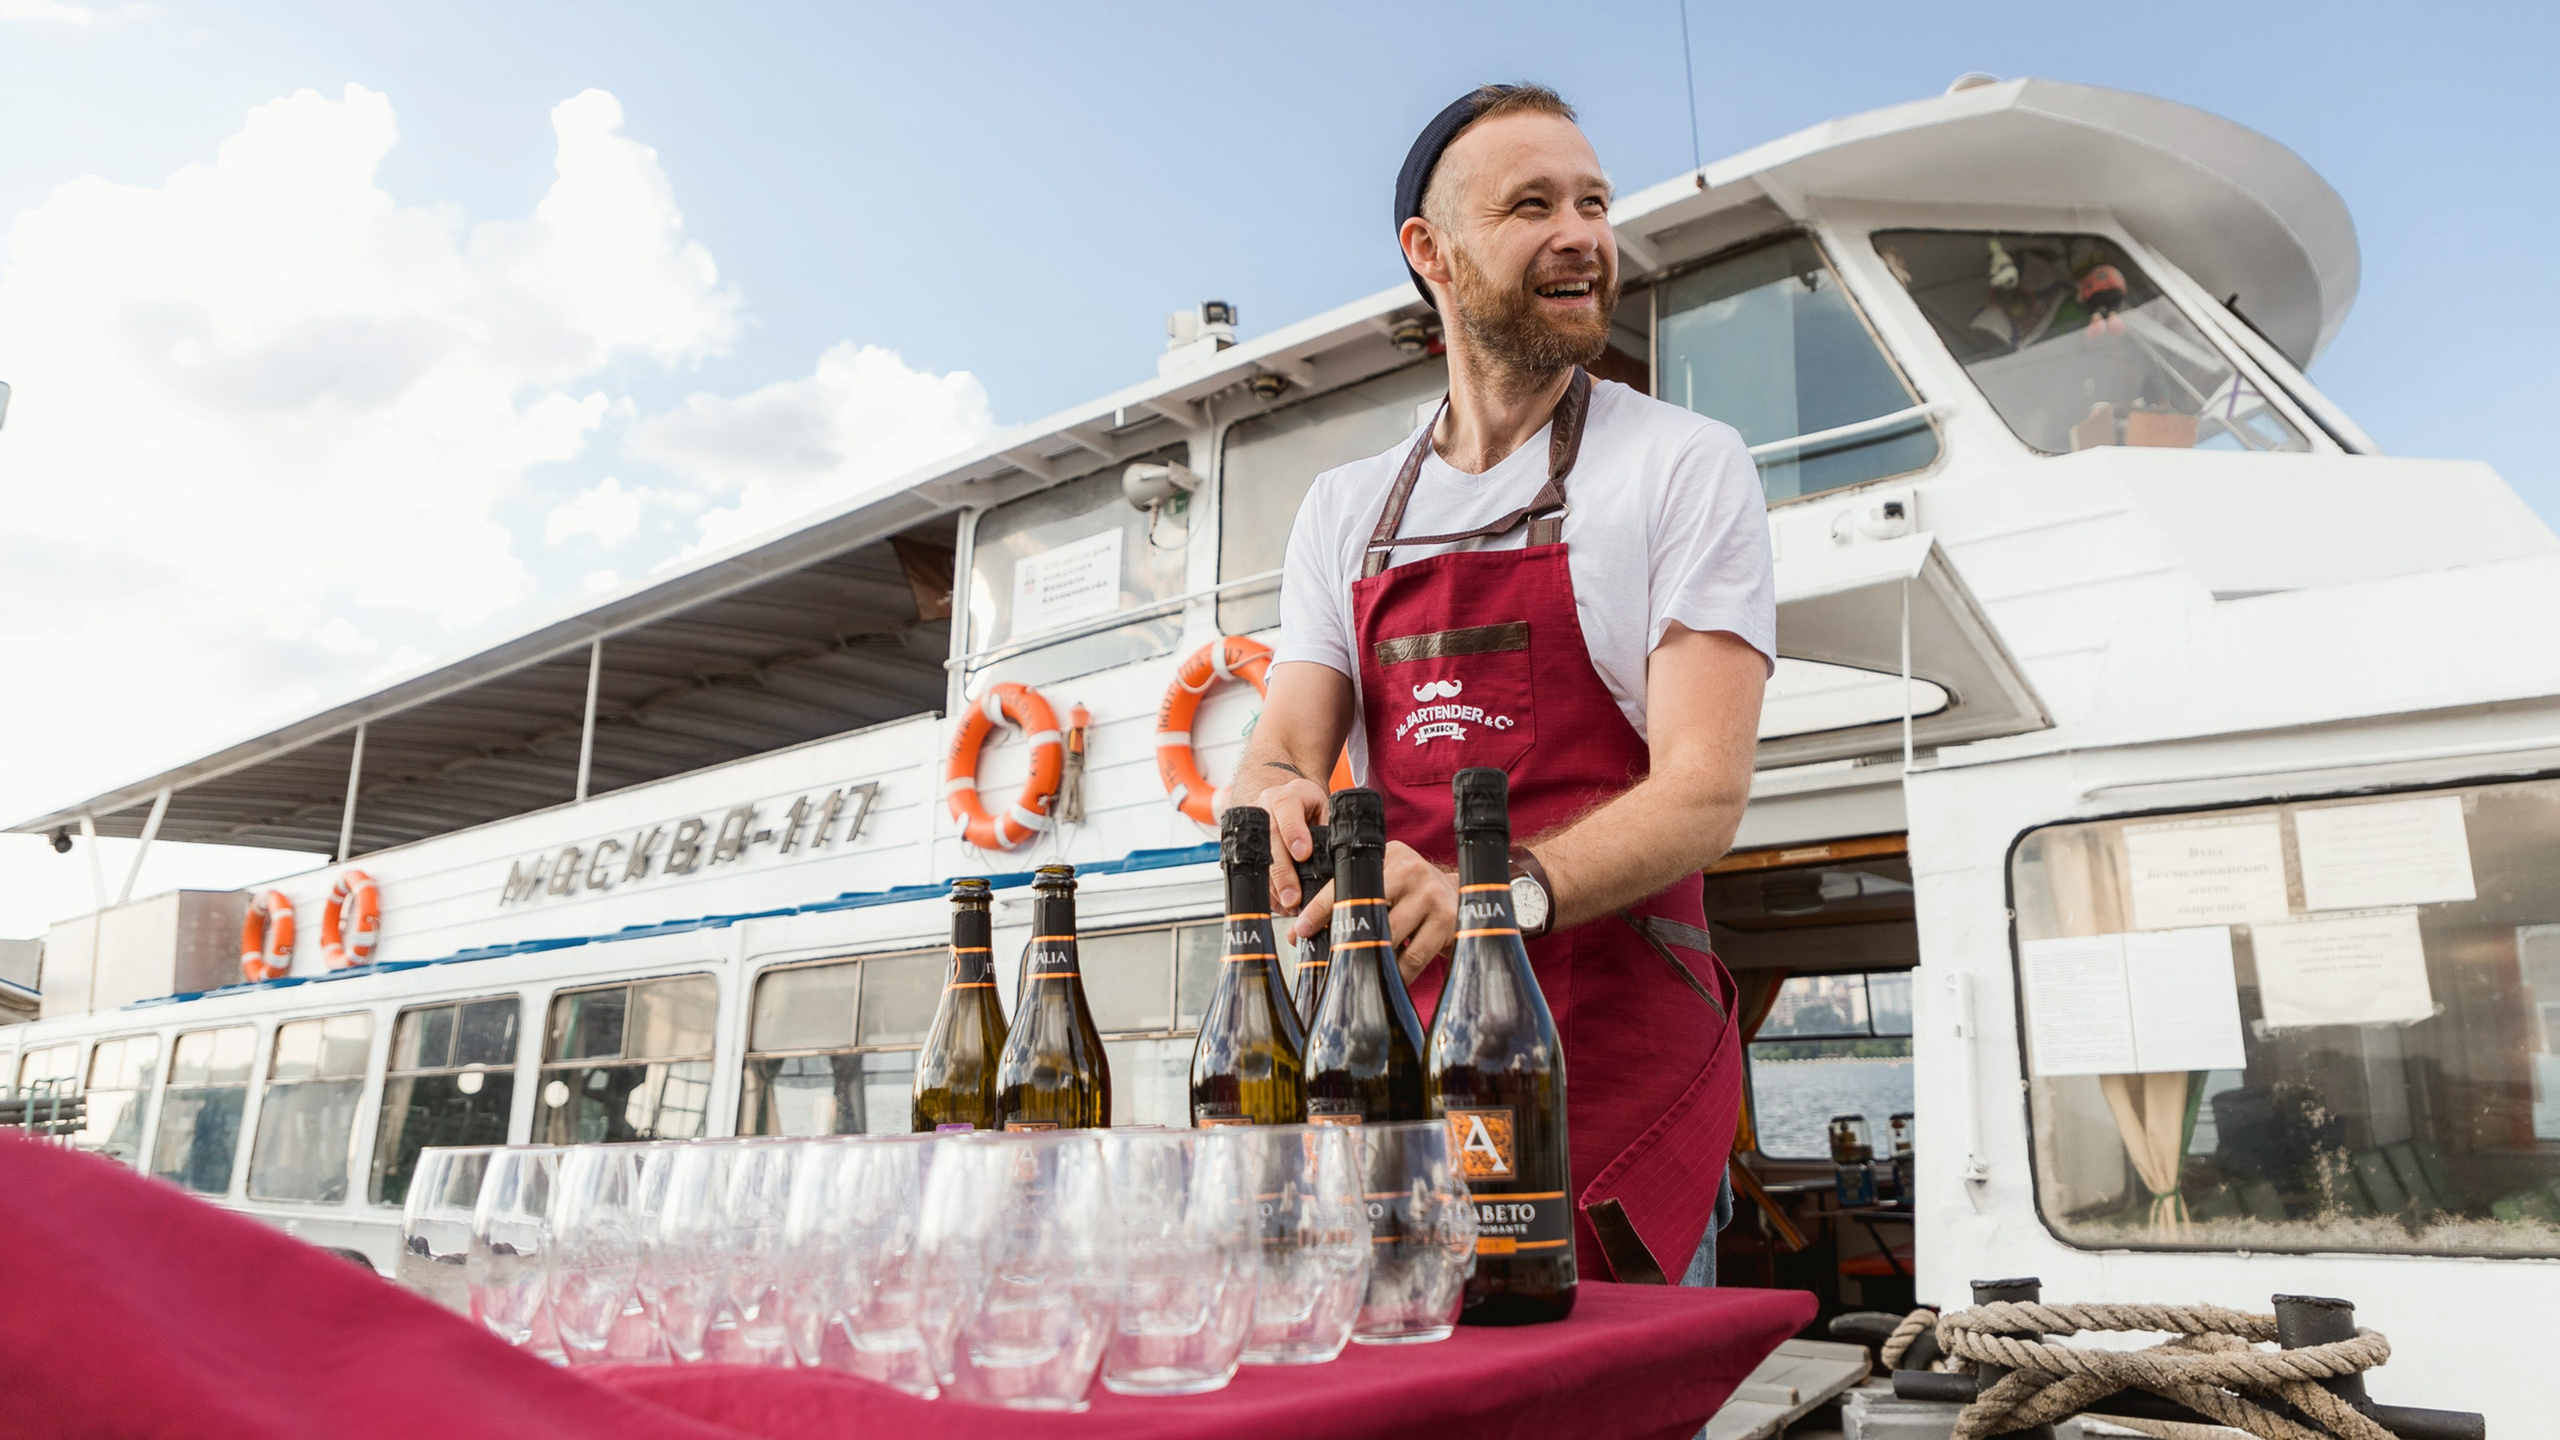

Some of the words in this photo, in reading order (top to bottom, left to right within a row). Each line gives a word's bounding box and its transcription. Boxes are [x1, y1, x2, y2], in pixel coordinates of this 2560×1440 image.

[1406, 704, 1484, 729] BARTENDER
[1484, 716, 1494, 727] &
[498, 781, 879, 907] МОСКВА-117
[1333, 917, 1370, 934] TALIA
[1449, 1115, 1509, 1173] A
[1472, 1203, 1536, 1223] ABETO
[1476, 1223, 1529, 1235] PUMANTE
